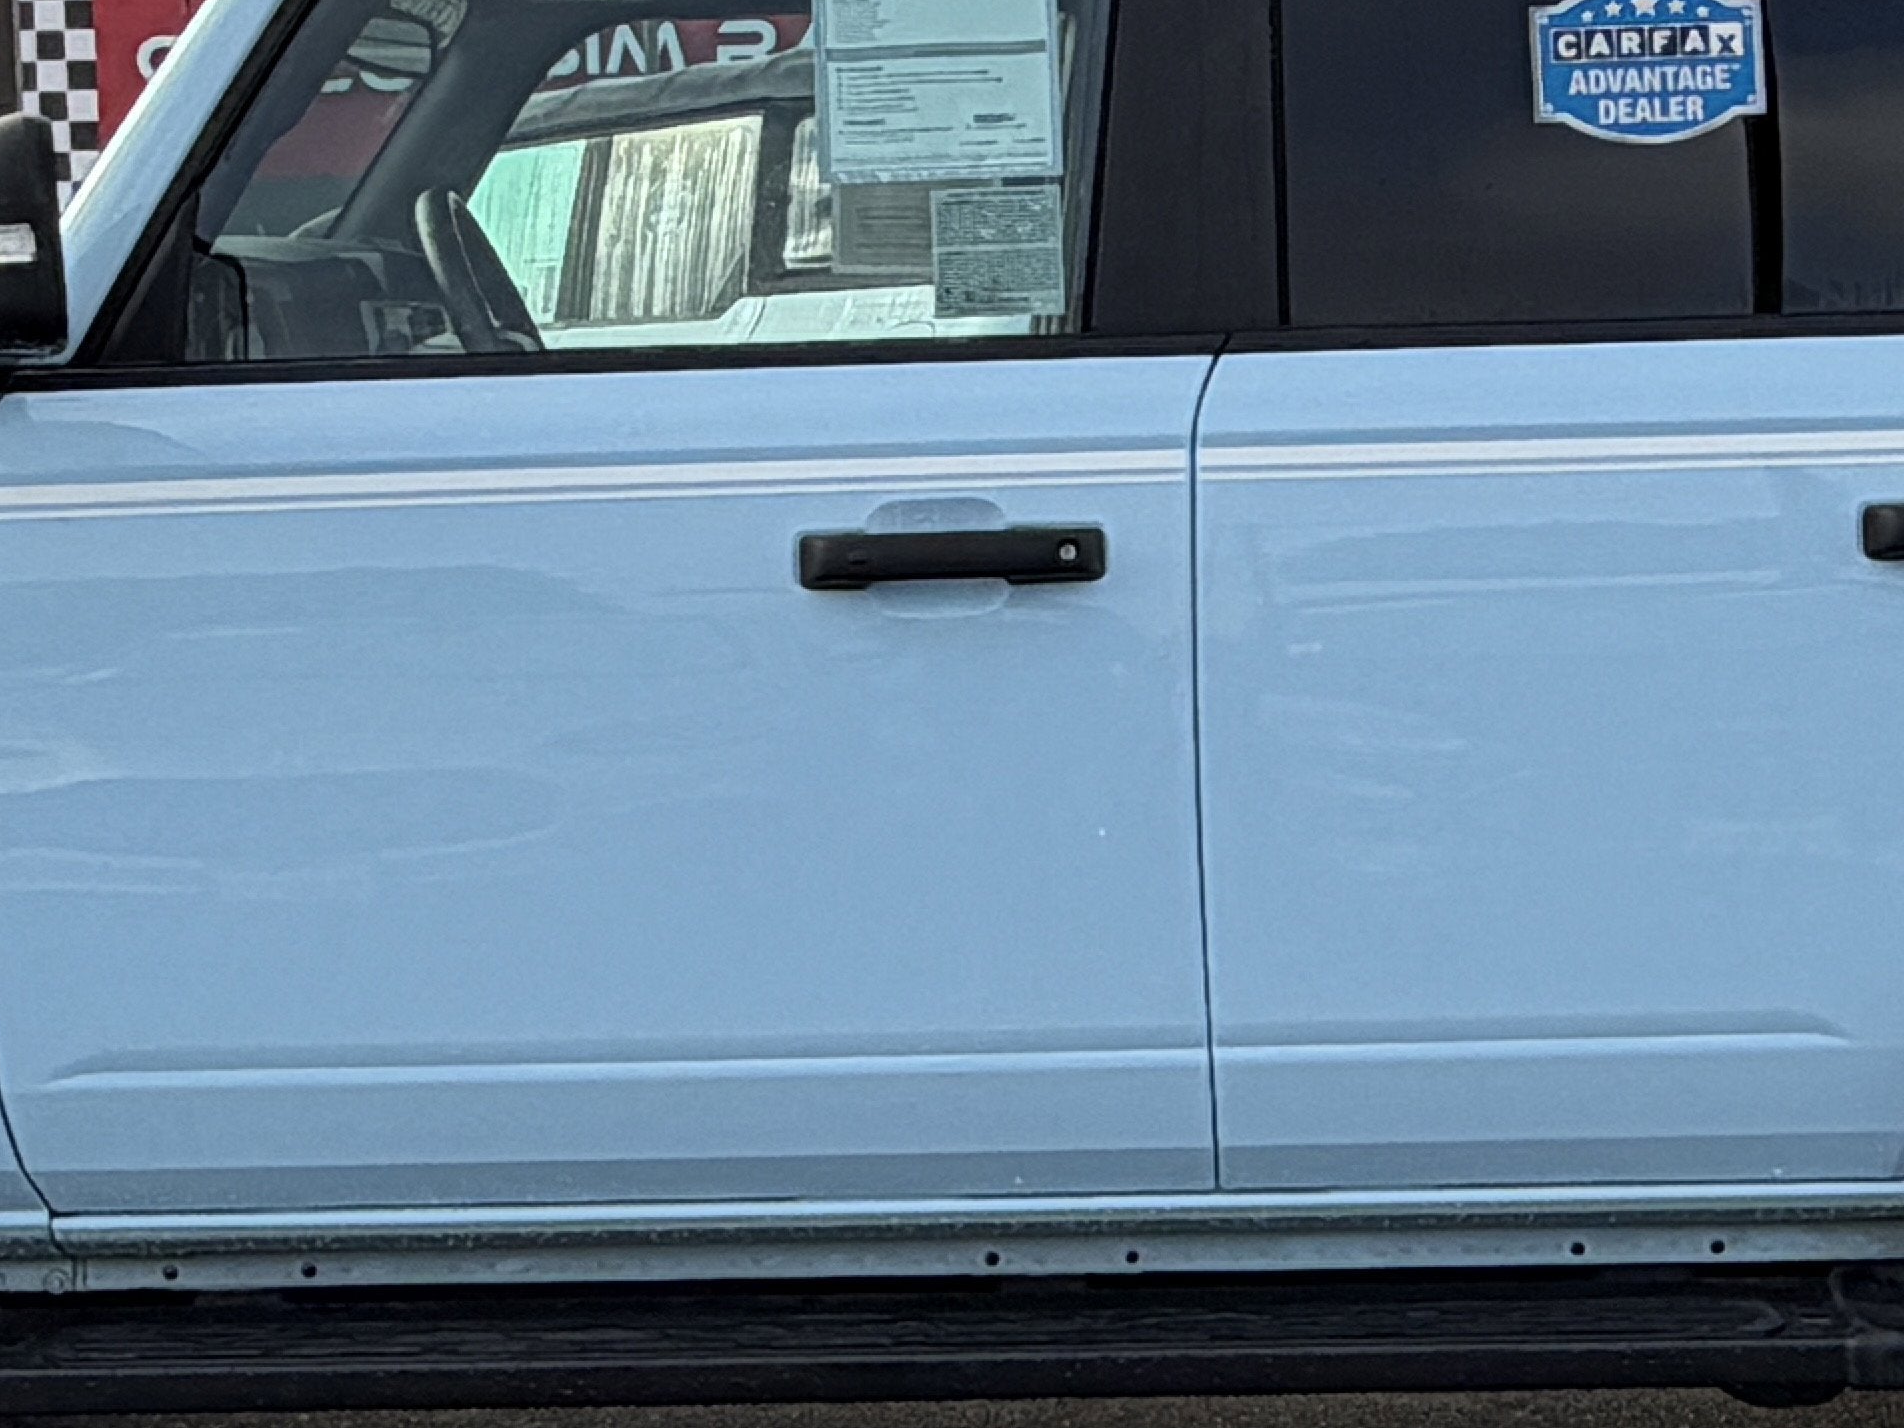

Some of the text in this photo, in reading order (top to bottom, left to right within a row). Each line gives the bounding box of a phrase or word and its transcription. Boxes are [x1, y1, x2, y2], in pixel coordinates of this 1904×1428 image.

[1553, 25, 1740, 60] CARFAX
[1568, 63, 1732, 95] ADVANTAGE
[1599, 95, 1705, 125] DEALER
